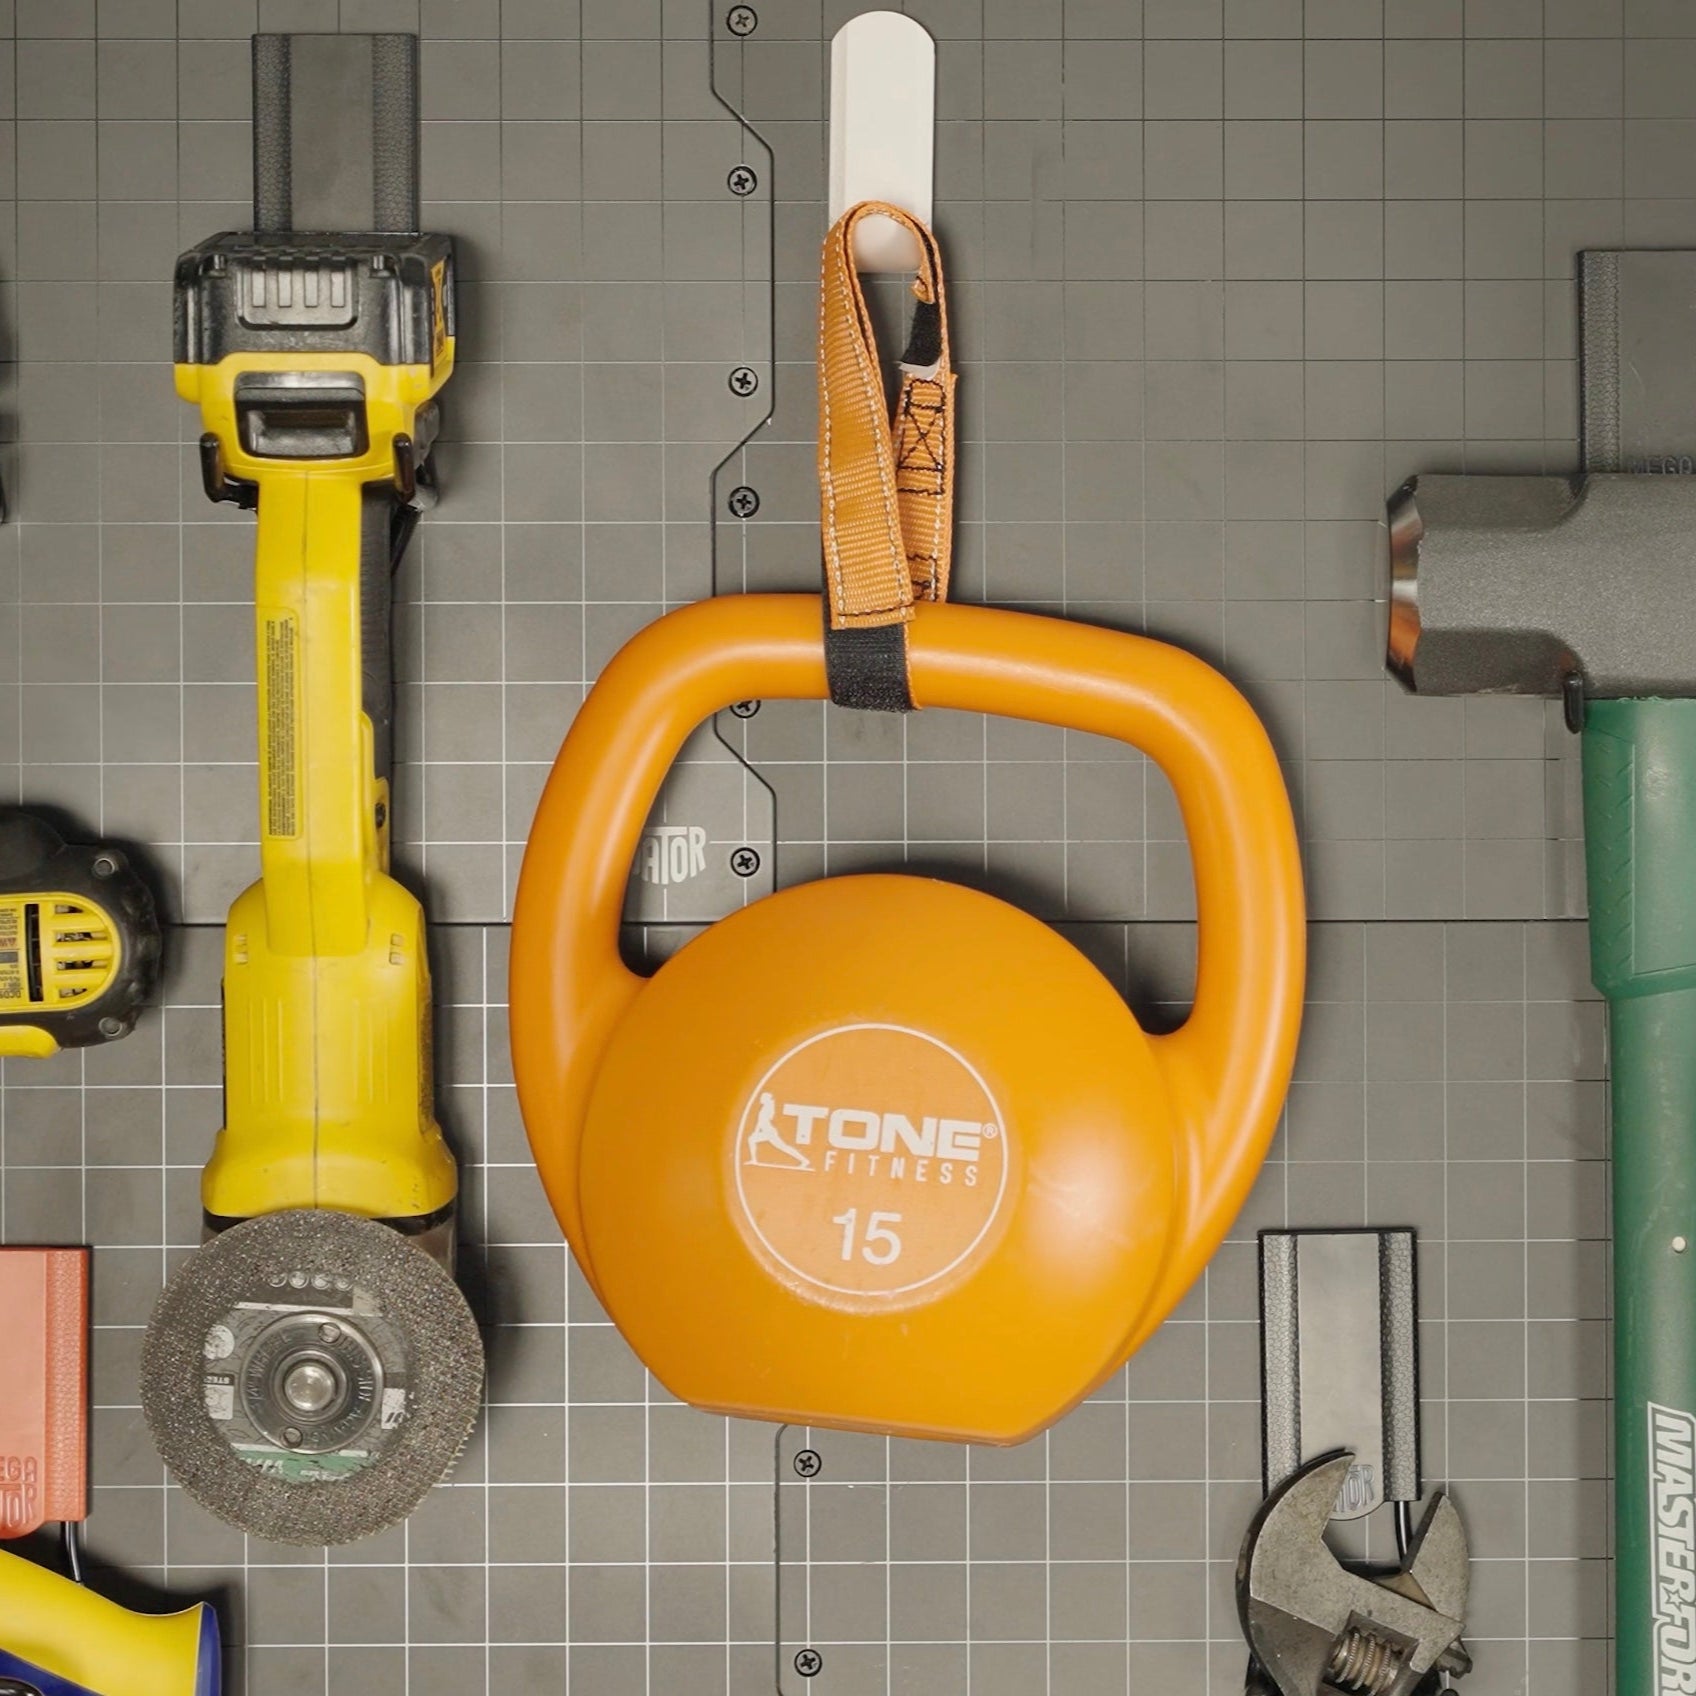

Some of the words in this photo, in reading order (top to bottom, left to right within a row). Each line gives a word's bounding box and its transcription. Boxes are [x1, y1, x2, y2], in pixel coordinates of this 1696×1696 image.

[634, 826, 706, 885] ATOR
[823, 1151, 979, 1188] FITNESS
[832, 1207, 902, 1266] 15
[1655, 1412, 1696, 1696] MASTERFOR
